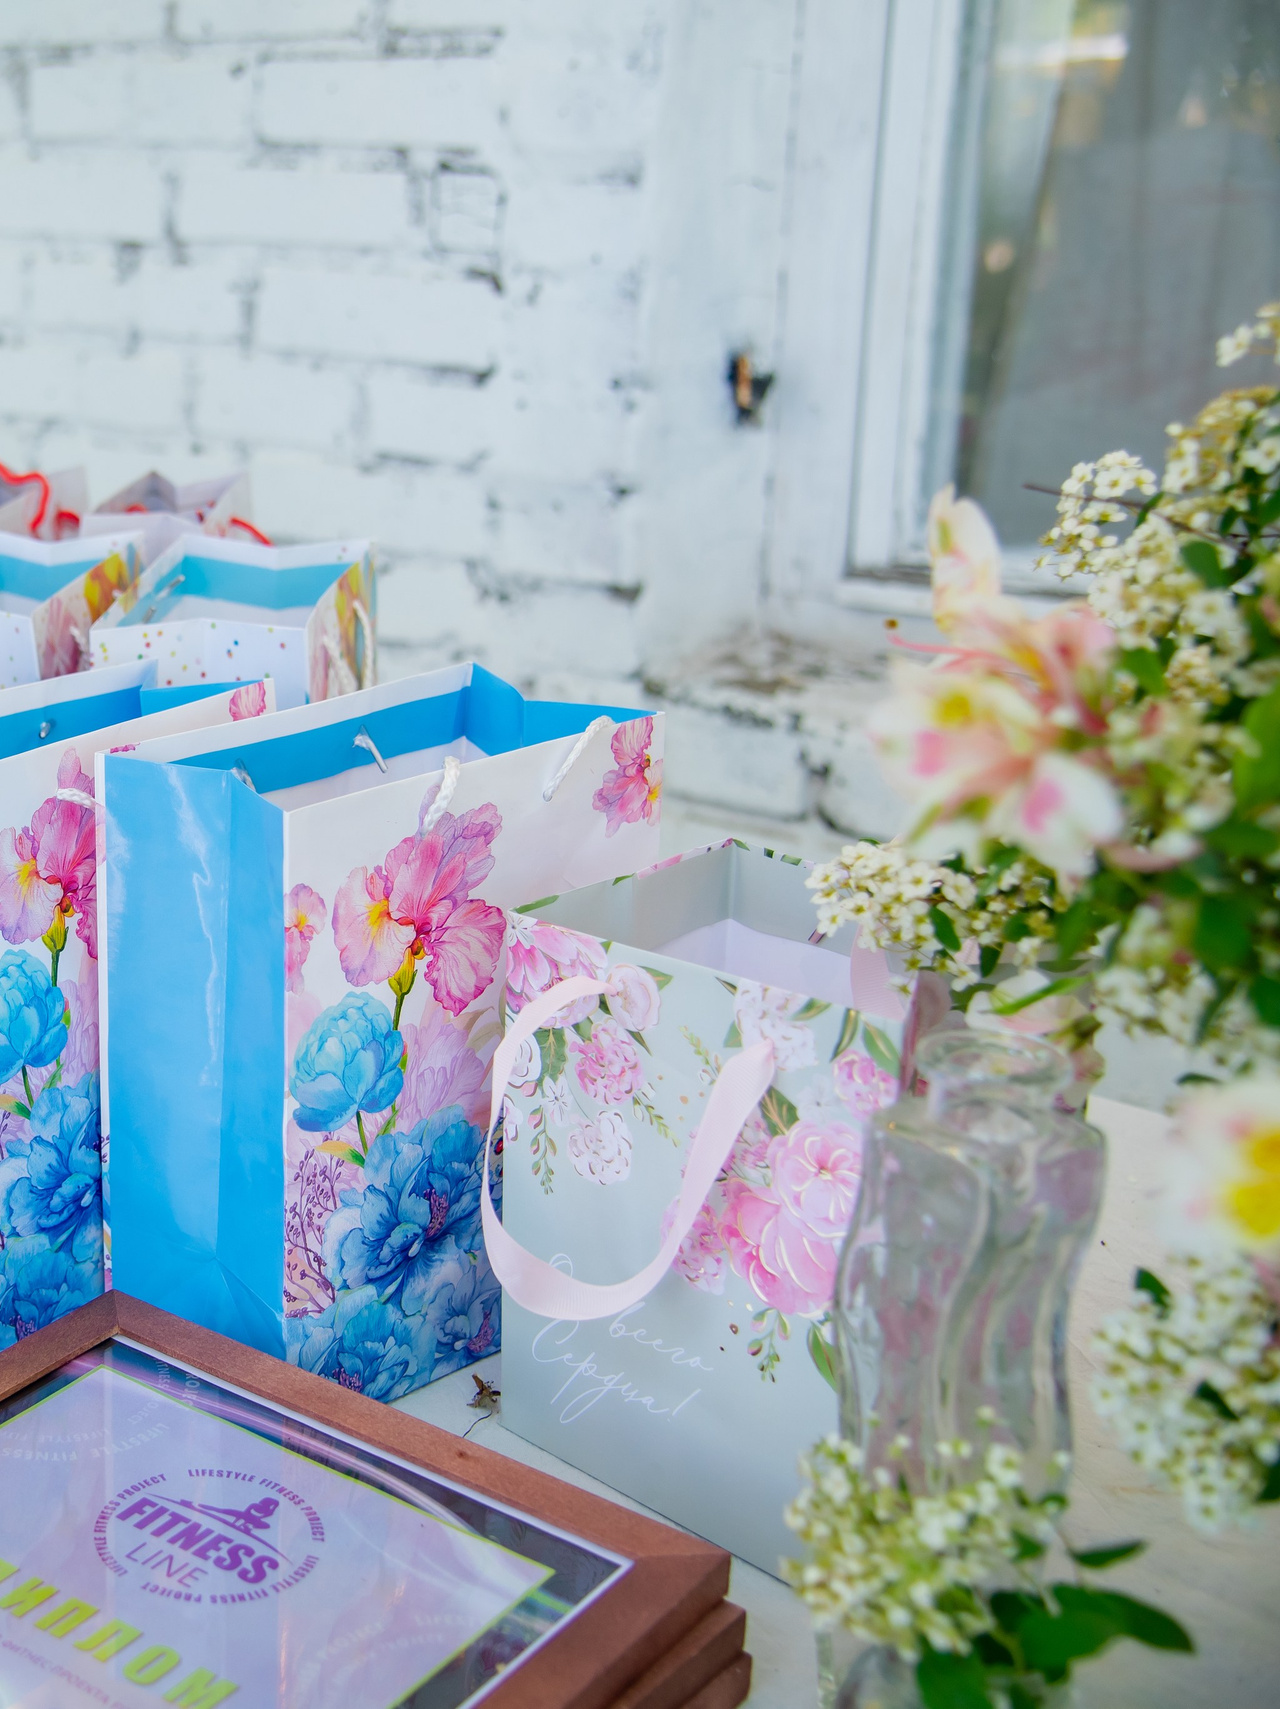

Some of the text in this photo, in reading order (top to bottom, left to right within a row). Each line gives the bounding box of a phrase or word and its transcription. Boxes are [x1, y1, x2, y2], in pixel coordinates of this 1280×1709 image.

[93, 1472, 168, 1578] LIFESTYLE FITNESS PROJECT
[116, 1496, 280, 1585] FITNESS
[187, 1468, 326, 1542] LIFESTYLE FITNESS PROJECT
[125, 1541, 209, 1589] LINE
[140, 1554, 320, 1605] LIFESTYLE FITNESS PROJECT
